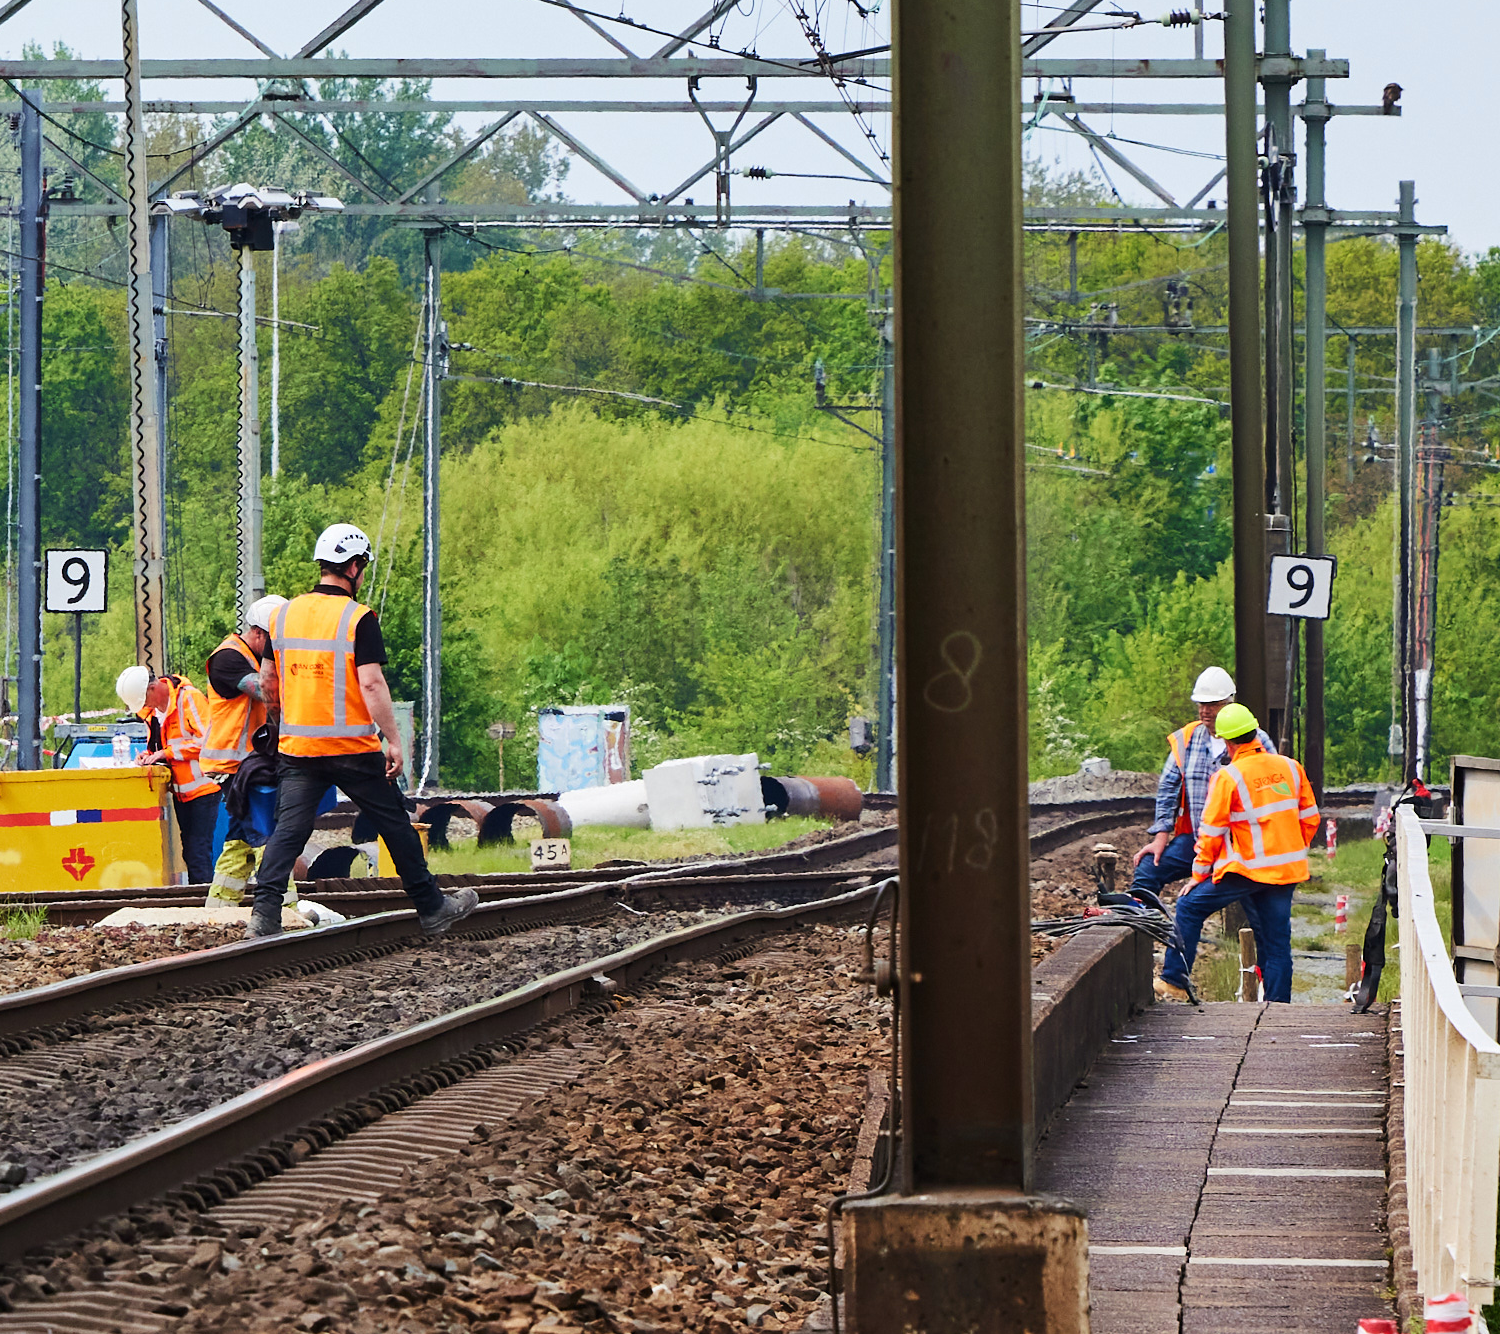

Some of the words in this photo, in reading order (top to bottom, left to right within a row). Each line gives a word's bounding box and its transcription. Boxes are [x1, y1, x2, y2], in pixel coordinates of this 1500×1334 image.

[62, 557, 90, 604] 9
[1287, 564, 1315, 609] 9
[924, 631, 983, 712] 8
